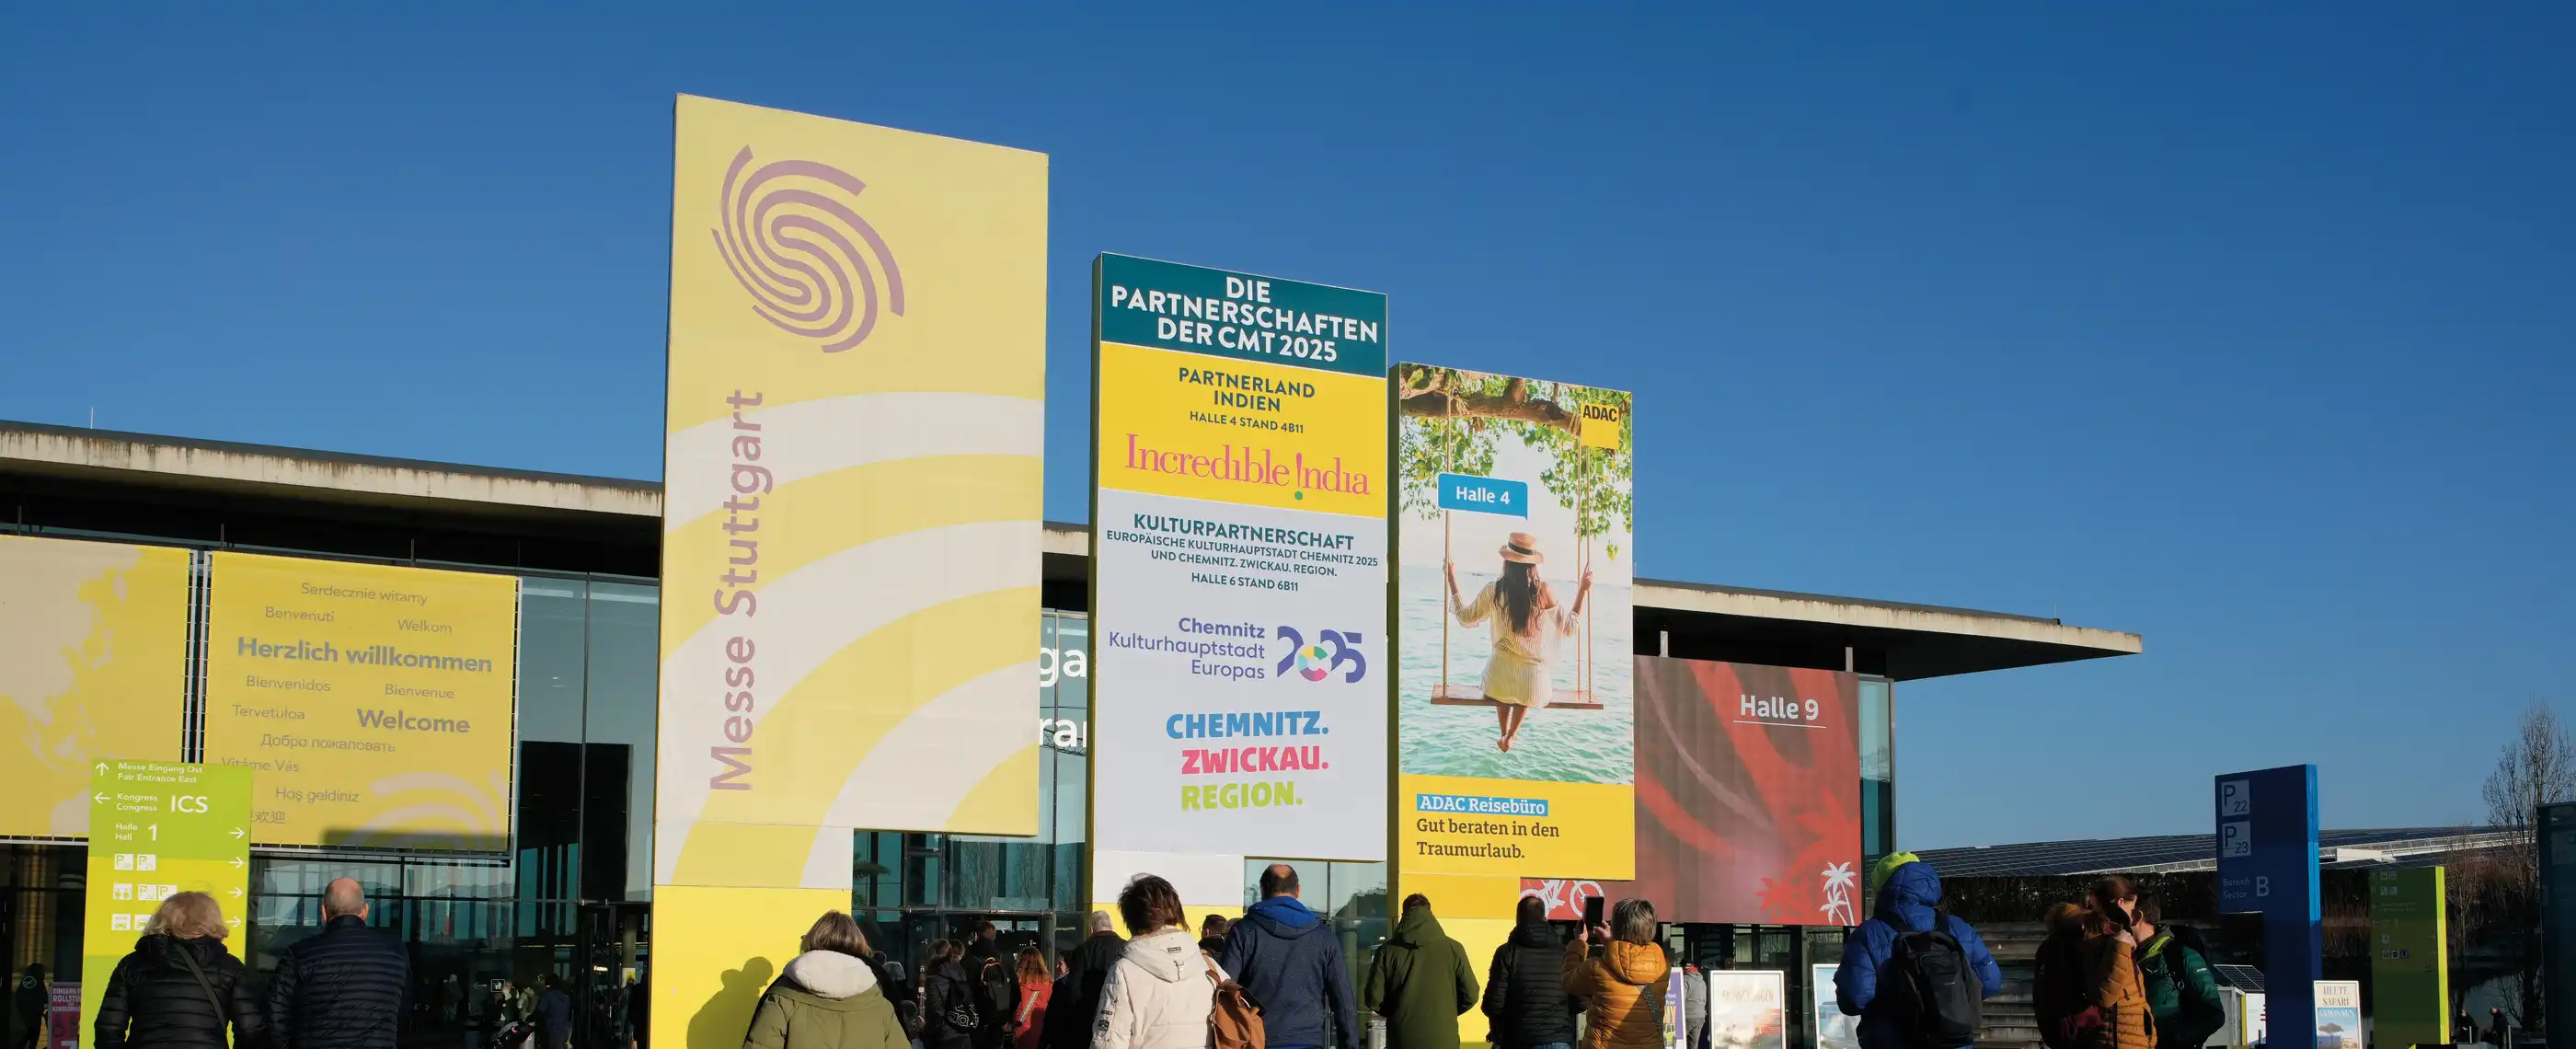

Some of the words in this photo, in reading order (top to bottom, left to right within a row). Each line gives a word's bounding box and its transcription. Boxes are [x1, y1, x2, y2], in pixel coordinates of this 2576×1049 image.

[1225, 276, 1271, 304] DIE
[1111, 285, 1377, 344] PARTNERSCHAFTEN
[1157, 317, 1213, 345] DER
[1218, 327, 1275, 353] CMT
[1279, 334, 1338, 363] 2025
[1179, 367, 1316, 398] PARTNERLAND
[1213, 390, 1281, 413] INDIEN
[1190, 410, 1227, 425] HALLE
[1229, 415, 1236, 426] 4
[1239, 417, 1278, 431] STAND
[1281, 421, 1304, 434] 4B11
[1582, 405, 1617, 422] ADAC
[1125, 432, 1290, 487] Incredible
[713, 389, 773, 617] Stuttgart
[1455, 486, 1495, 503] Halle
[1500, 490, 1510, 505] 4
[1133, 513, 1354, 550] KULTURPARTNERSCHAFT
[1107, 530, 1186, 548] EUROPÄISCHE
[1188, 539, 1298, 559] KULTURHAUPTSTADT
[1300, 550, 1354, 565] CHEMNITZ
[1355, 556, 1378, 568] 2025
[1151, 550, 1177, 561] UND
[1179, 553, 1238, 569] CHEMNITZ.
[1240, 559, 1292, 573] ZWICKAU.
[1294, 564, 1338, 577] REGION.
[1191, 572, 1227, 585] HALLE
[1229, 576, 1236, 586] 6
[1238, 577, 1276, 590] STAND
[1277, 581, 1299, 592] 6B11
[302, 582, 375, 600] Serdecznie
[380, 590, 428, 606] witamy
[265, 606, 334, 622] Benvenuti
[397, 618, 453, 635] Welkom
[1179, 617, 1266, 640] Chemnitz
[237, 637, 339, 663] Herzlich
[346, 644, 492, 673] willkommen
[1109, 631, 1266, 660] Kulturhauptstadt
[1191, 659, 1265, 682] Europas
[247, 675, 331, 692] Bienvenidos
[385, 684, 454, 699] Bienvenue
[232, 704, 305, 720] Tervetuloa
[709, 636, 755, 790] Messe
[1740, 694, 1800, 720] Halle
[1804, 697, 1820, 721] 9
[357, 709, 470, 733] Welcome
[1166, 710, 1329, 740] CHEMNITZ.
[260, 733, 307, 750] Добро
[311, 738, 397, 753] пожаловать
[118, 762, 147, 770] Messe
[149, 764, 185, 774] Eingang
[275, 760, 299, 772] Vás
[1181, 745, 1329, 776] ZWICKAU.
[138, 774, 176, 782] Entrance
[117, 793, 158, 802] Kongress
[170, 795, 209, 813] ICS
[276, 788, 303, 802] Hoş
[307, 789, 360, 803] geldiniz
[1181, 781, 1303, 812] REGION.
[1420, 795, 1466, 811] ADAC
[1468, 798, 1546, 815] Reisebüro
[2224, 785, 2236, 807] P
[2234, 800, 2248, 813] 22
[117, 803, 157, 813] Congress
[115, 833, 132, 841] Hall
[116, 823, 138, 831] Halle
[148, 824, 157, 842] 1
[1417, 818, 1445, 833] Gut
[1448, 819, 1509, 836] beraten
[1512, 821, 1528, 836] in
[1531, 822, 1560, 837] den
[1417, 841, 1525, 859] Traumurlaub.
[2225, 826, 2237, 847] P
[2235, 842, 2248, 854] 23
[2223, 877, 2250, 887] Bereich
[2256, 876, 2270, 897] B
[2223, 890, 2248, 899] Sector
[2322, 997, 2350, 1006] SAFARI
